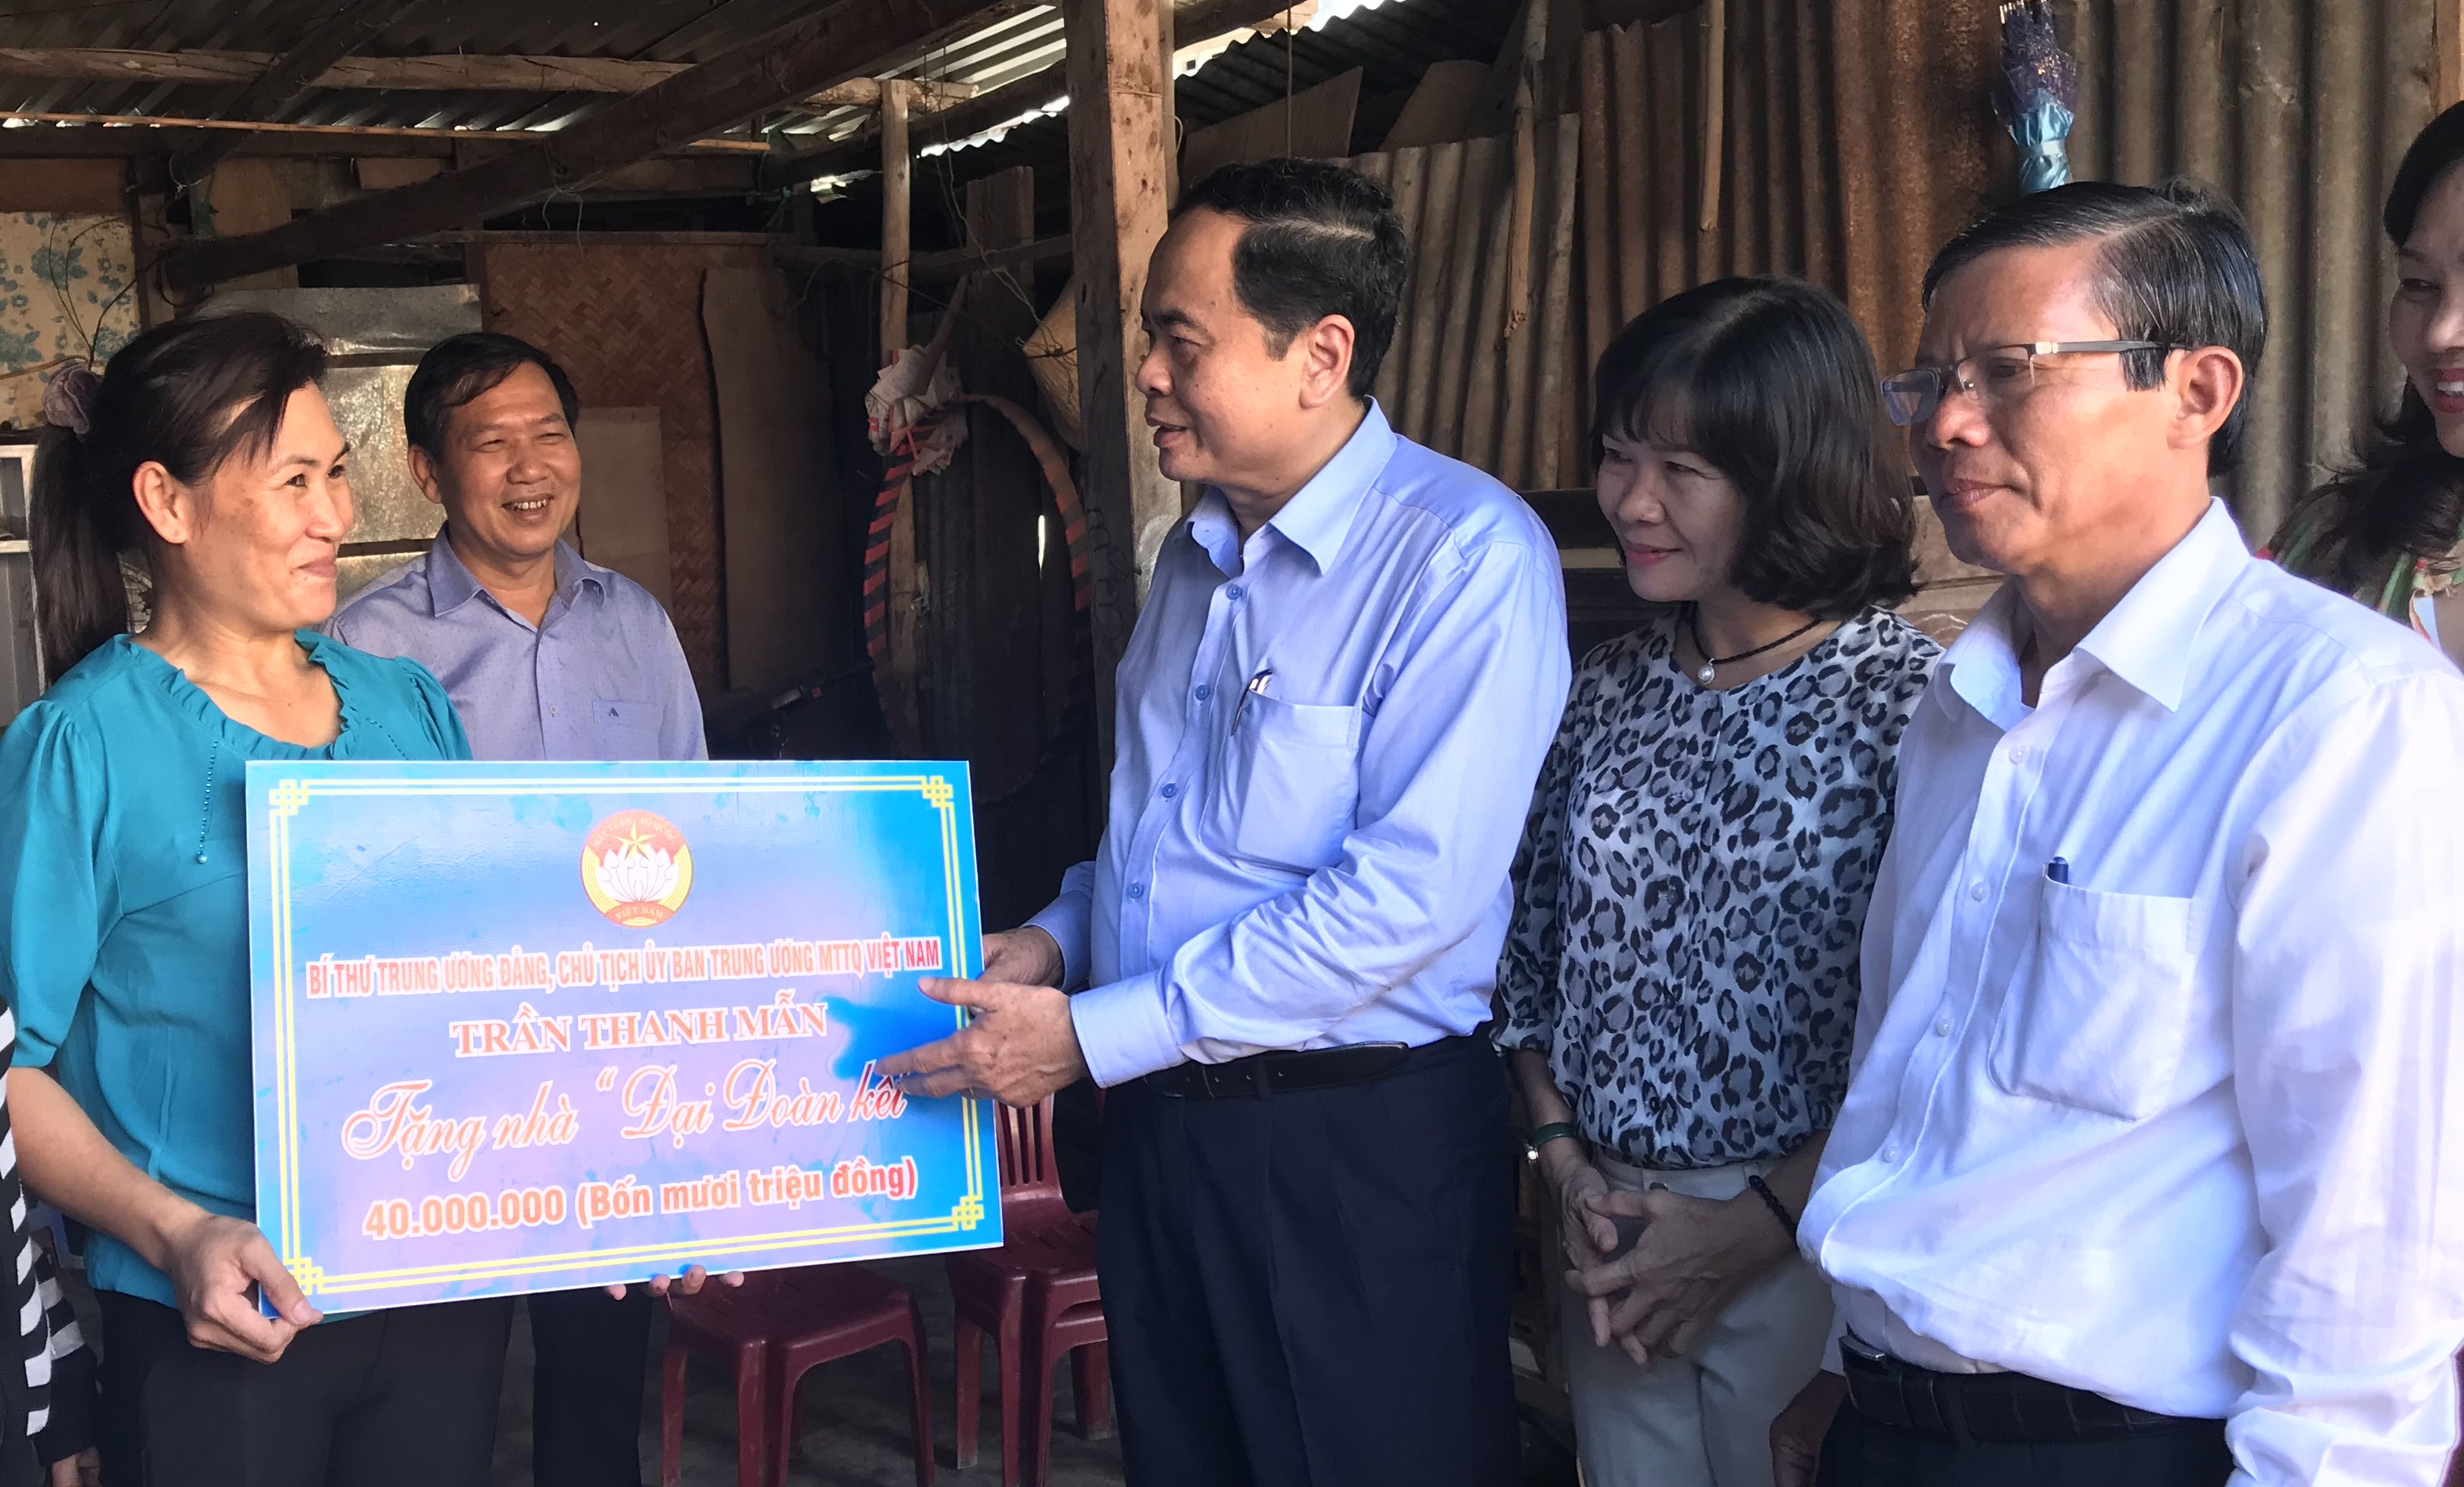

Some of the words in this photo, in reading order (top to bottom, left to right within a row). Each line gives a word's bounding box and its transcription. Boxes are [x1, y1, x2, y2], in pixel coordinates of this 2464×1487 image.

[641, 906, 665, 919] NAM
[308, 954, 330, 996] BÍ
[333, 956, 372, 995] THƯ
[377, 958, 439, 993] TRUNG
[443, 953, 494, 991] ƯƠNG
[498, 947, 554, 991] ĐẢNG,
[557, 943, 596, 985] CHỦ
[599, 950, 641, 991] TỊCH
[644, 941, 667, 981] ỦY
[672, 949, 706, 980] BAN
[709, 945, 765, 978] TRUNG
[769, 941, 815, 975] ƯƠNG
[818, 941, 863, 975] MTTQ
[865, 934, 901, 977] VIỆT
[903, 938, 941, 969] NAM
[452, 1004, 571, 1056] TRẦN
[580, 1010, 728, 1050] THANH
[734, 991, 827, 1038] MẪN
[343, 1081, 487, 1181] Tặng
[494, 1082, 578, 1147] nhà
[724, 1060, 843, 1128] Đoàn
[364, 1188, 565, 1238] 40.000.000
[577, 1176, 652, 1227] (Bốn
[662, 1172, 740, 1212] mươi
[747, 1167, 822, 1209] triệu
[831, 1157, 918, 1199] đồng)
